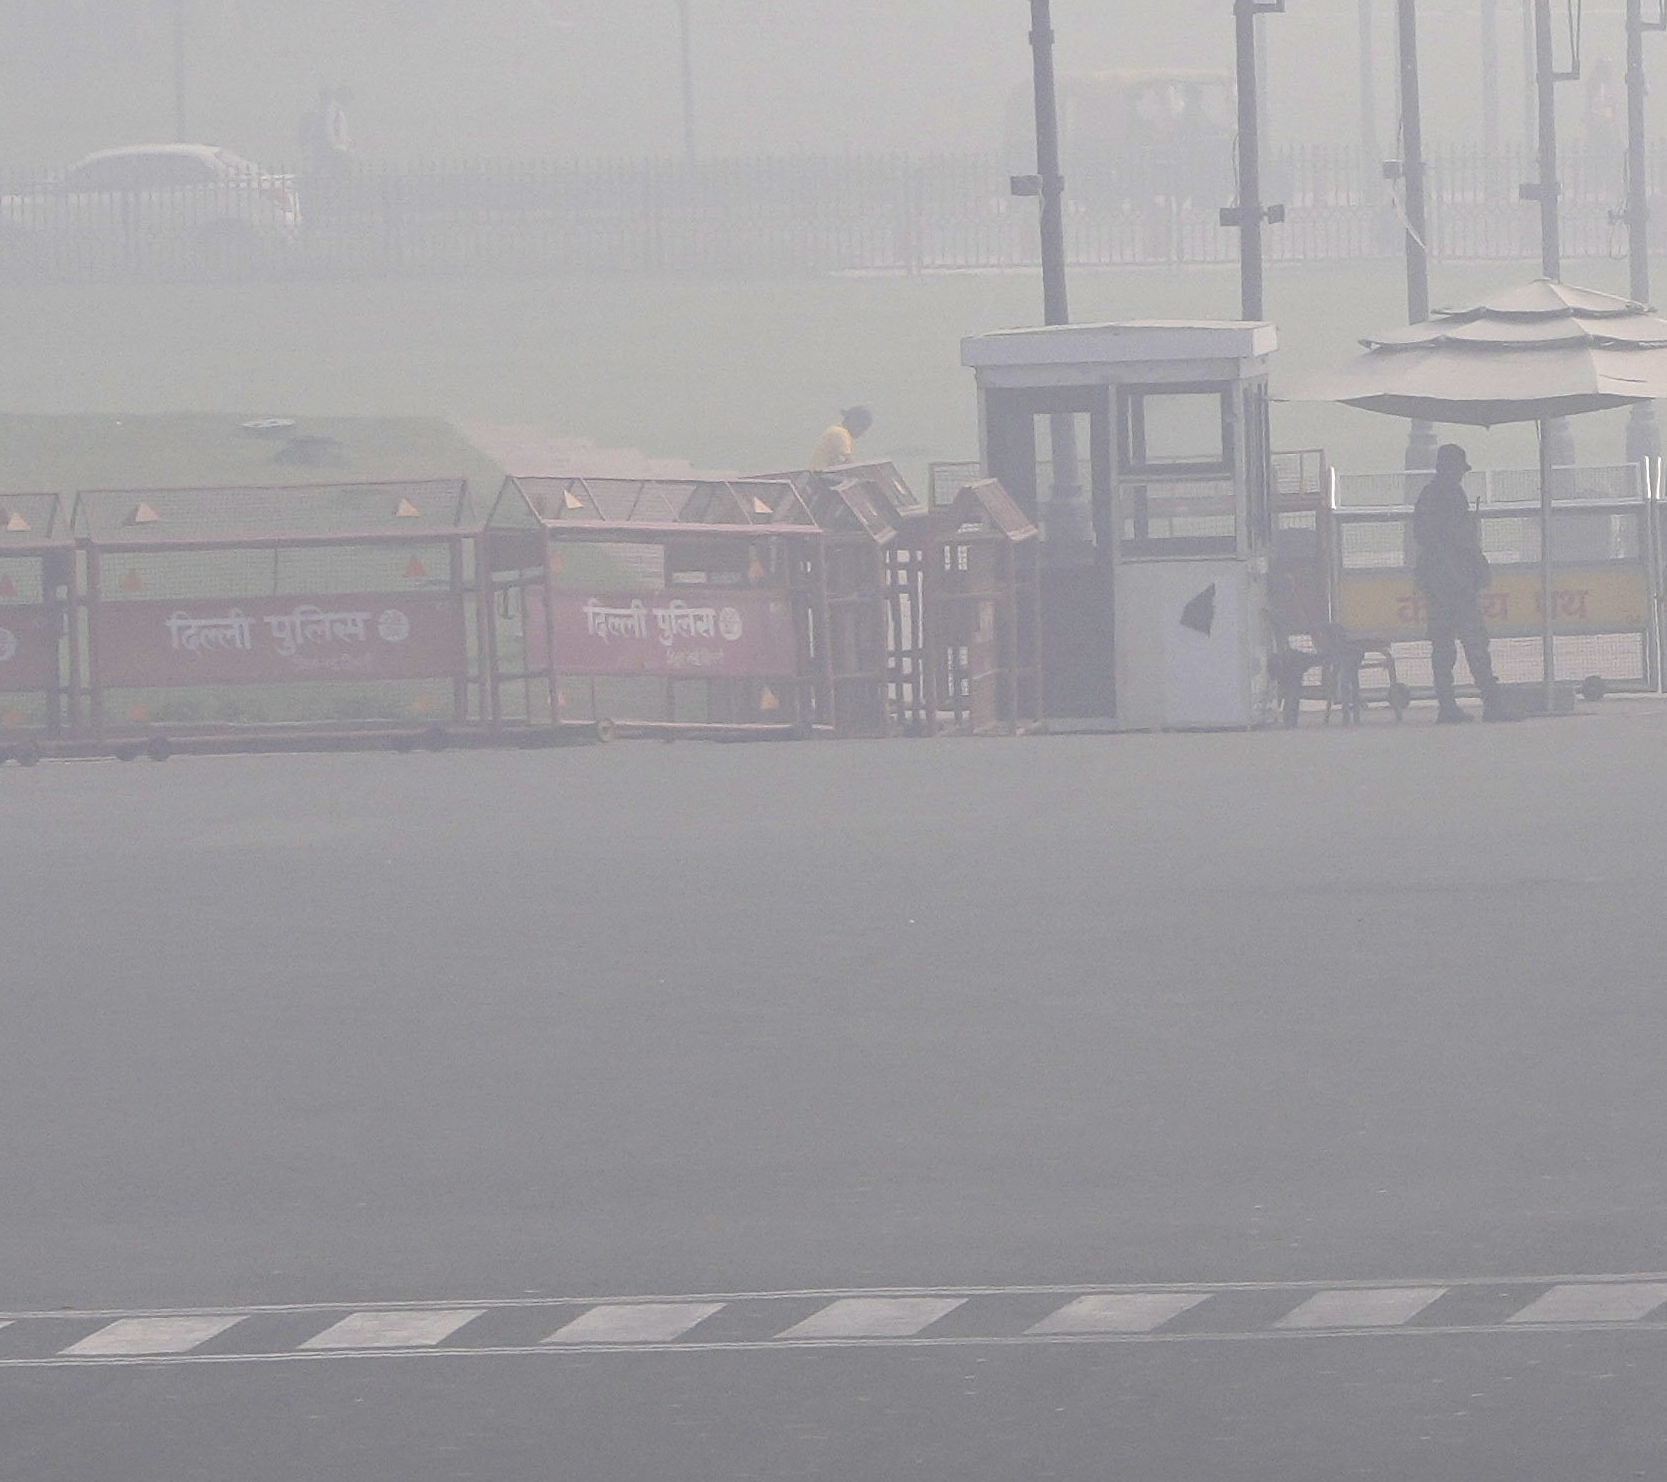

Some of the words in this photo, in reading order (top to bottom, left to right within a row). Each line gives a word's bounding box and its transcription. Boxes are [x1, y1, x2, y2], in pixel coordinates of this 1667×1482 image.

[165, 607, 257, 657] दिल्ली
[263, 605, 372, 657] पुलिस
[583, 597, 649, 645] दिल्ली
[652, 599, 716, 646] पुलिस
